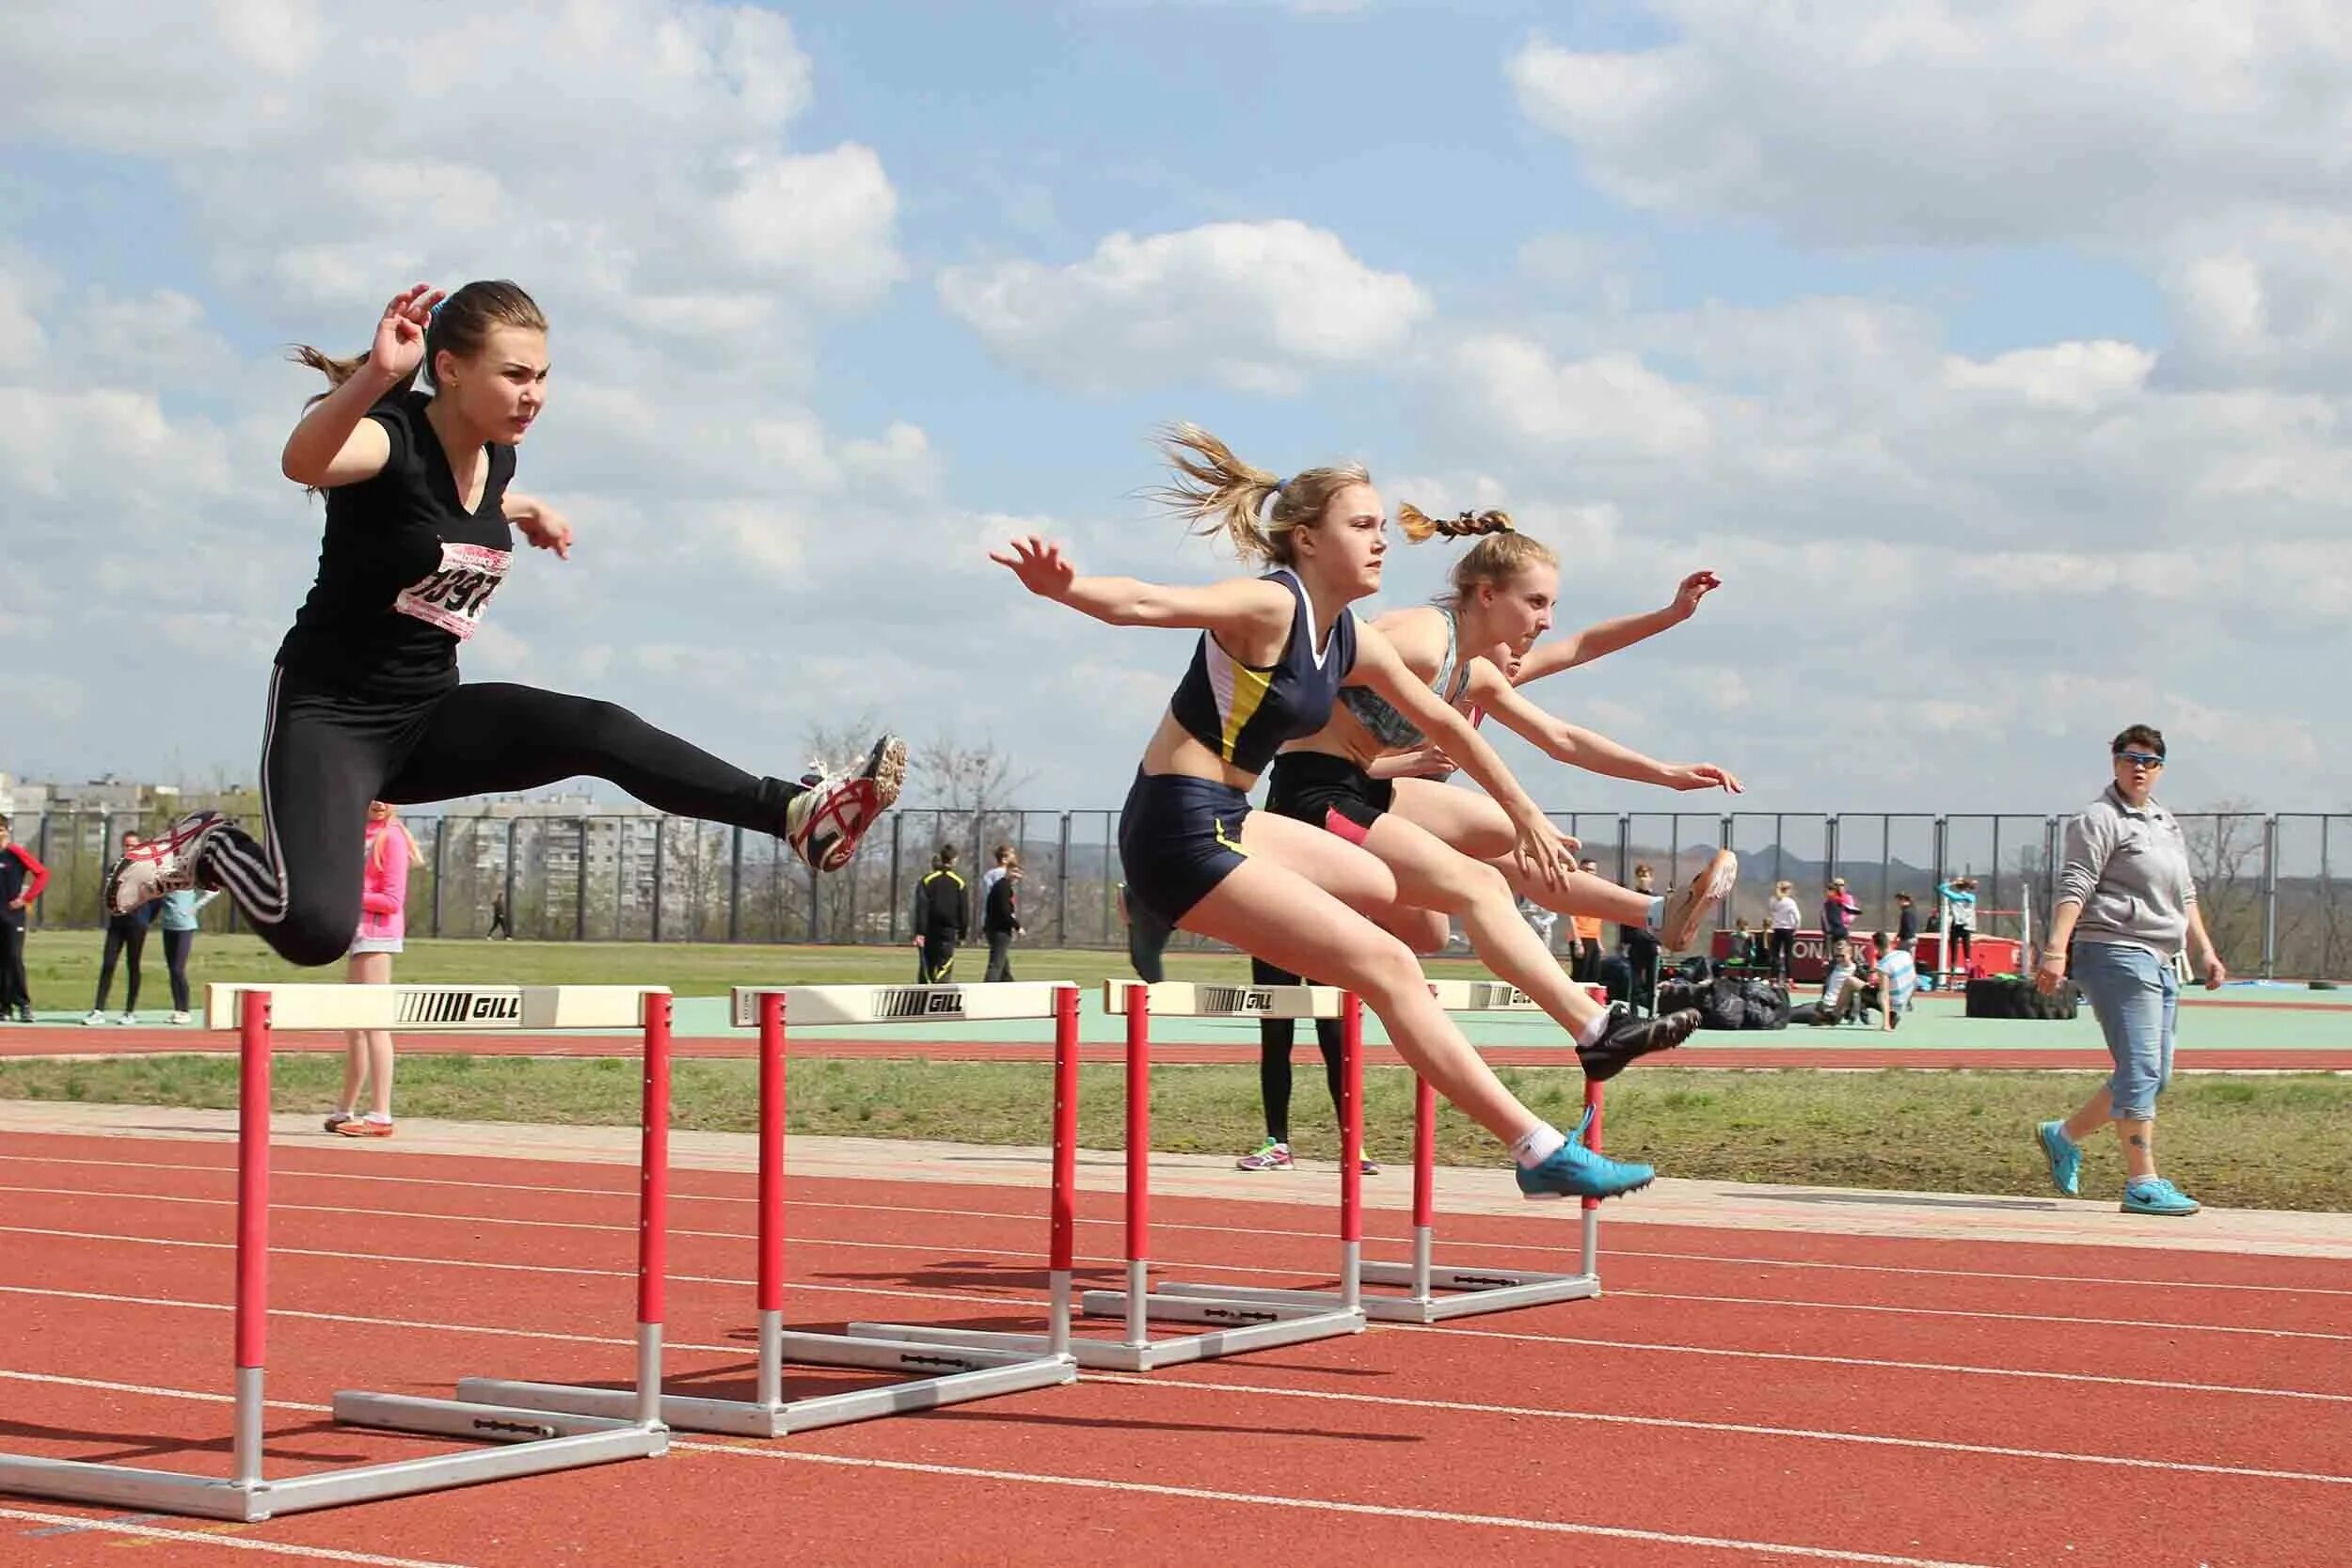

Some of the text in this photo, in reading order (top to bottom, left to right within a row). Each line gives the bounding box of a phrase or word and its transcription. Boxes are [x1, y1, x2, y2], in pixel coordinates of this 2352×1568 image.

[472, 997, 519, 1019] GILL
[929, 993, 962, 1012] GILL
[1247, 993, 1272, 1010] GILL
